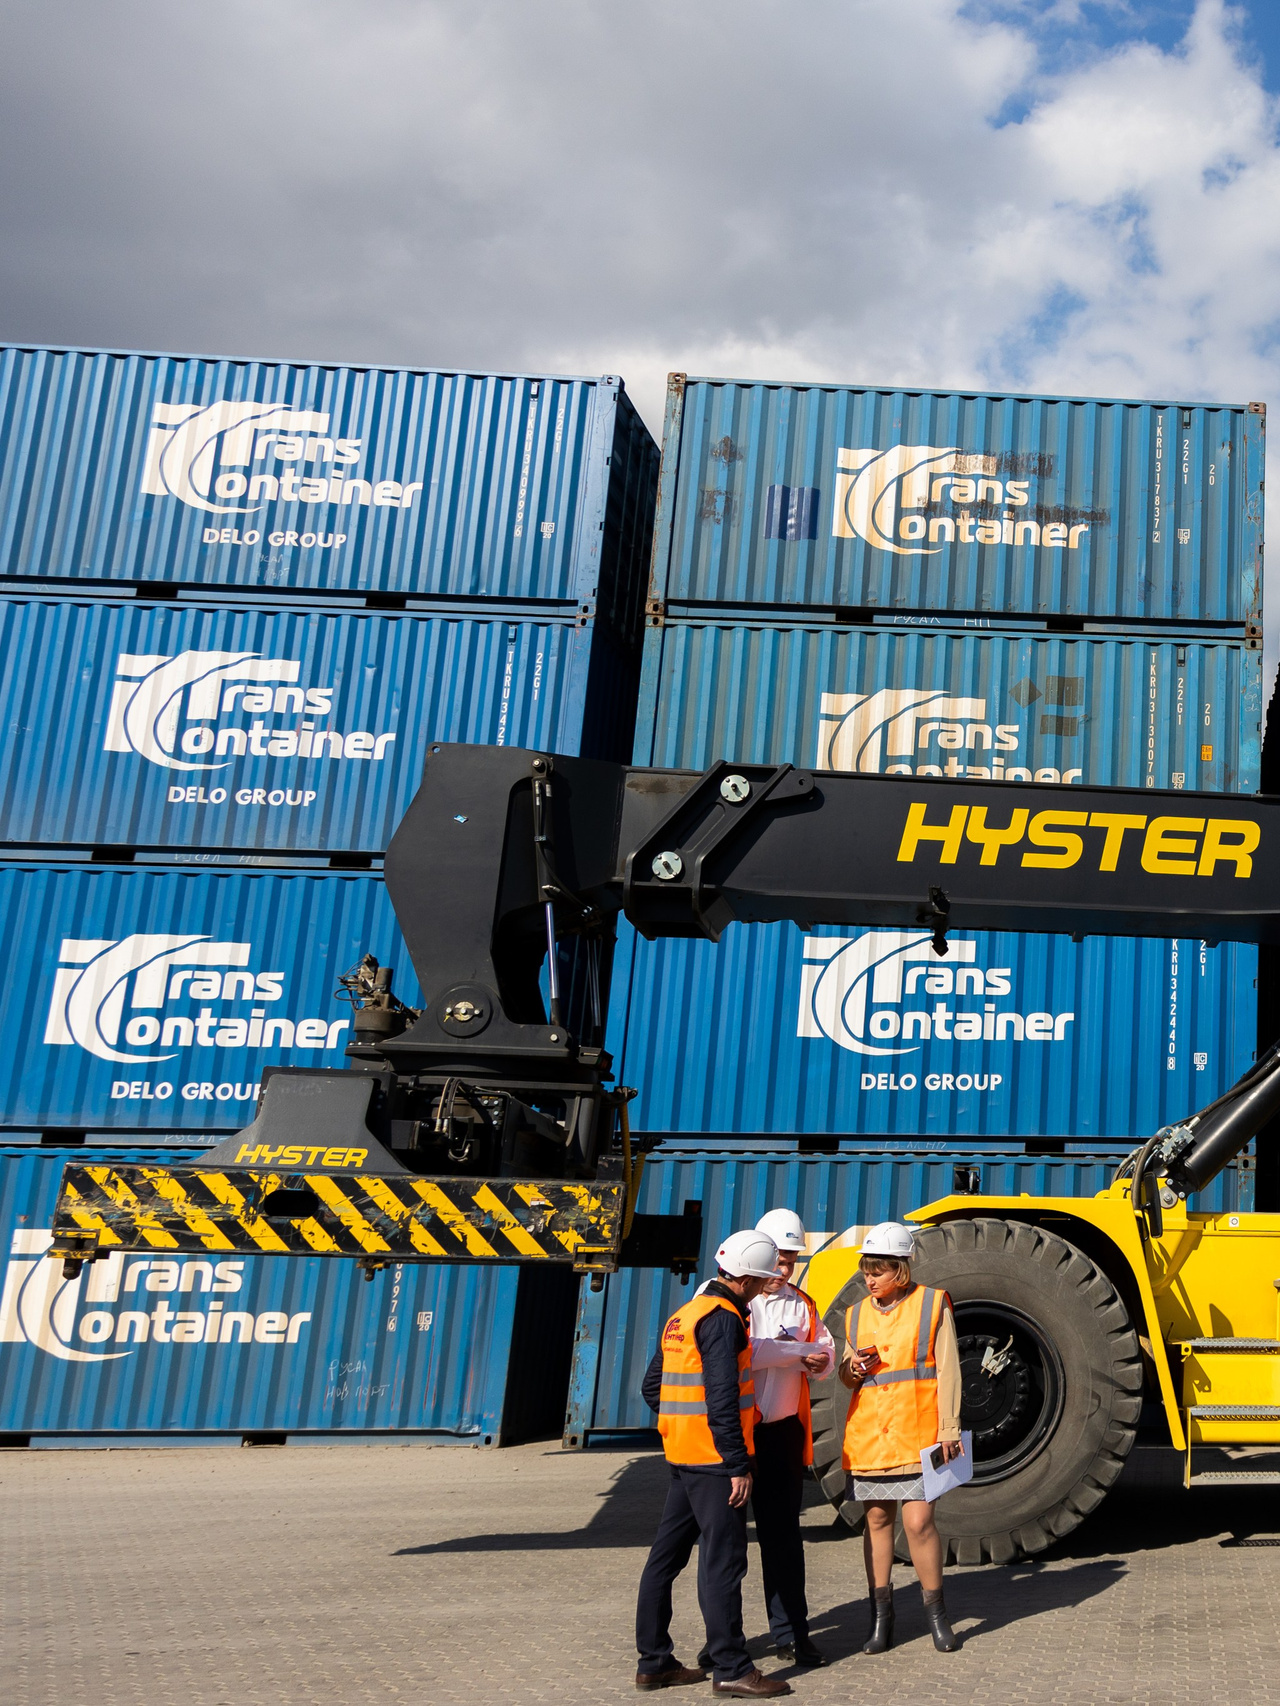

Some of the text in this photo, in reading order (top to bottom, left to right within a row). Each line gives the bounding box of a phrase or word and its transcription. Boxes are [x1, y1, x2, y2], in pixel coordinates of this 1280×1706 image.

[161, 400, 424, 514] Container
[219, 410, 362, 466] Trans
[554, 408, 564, 453] 22G1
[848, 444, 1090, 555] Container
[900, 453, 1030, 508] Trans
[1208, 464, 1216, 486] 20
[203, 528, 347, 549] DELO GROUP
[186, 658, 334, 720] Trans
[533, 652, 543, 701] 22G1
[1176, 678, 1184, 725] 22G1
[126, 650, 396, 771] Container
[886, 697, 1020, 756] Trans
[1204, 703, 1211, 726] 20
[167, 786, 317, 807] DELO GROUP
[896, 802, 1261, 878] HYSTER
[130, 942, 285, 1008] Trans
[814, 931, 1075, 1056] Container
[872, 938, 1011, 1003] Trans
[67, 934, 350, 1063] Container
[110, 1081, 173, 1100] DELO
[860, 1073, 1002, 1090] DELO GROUP
[234, 1144, 369, 1167] HYSTER
